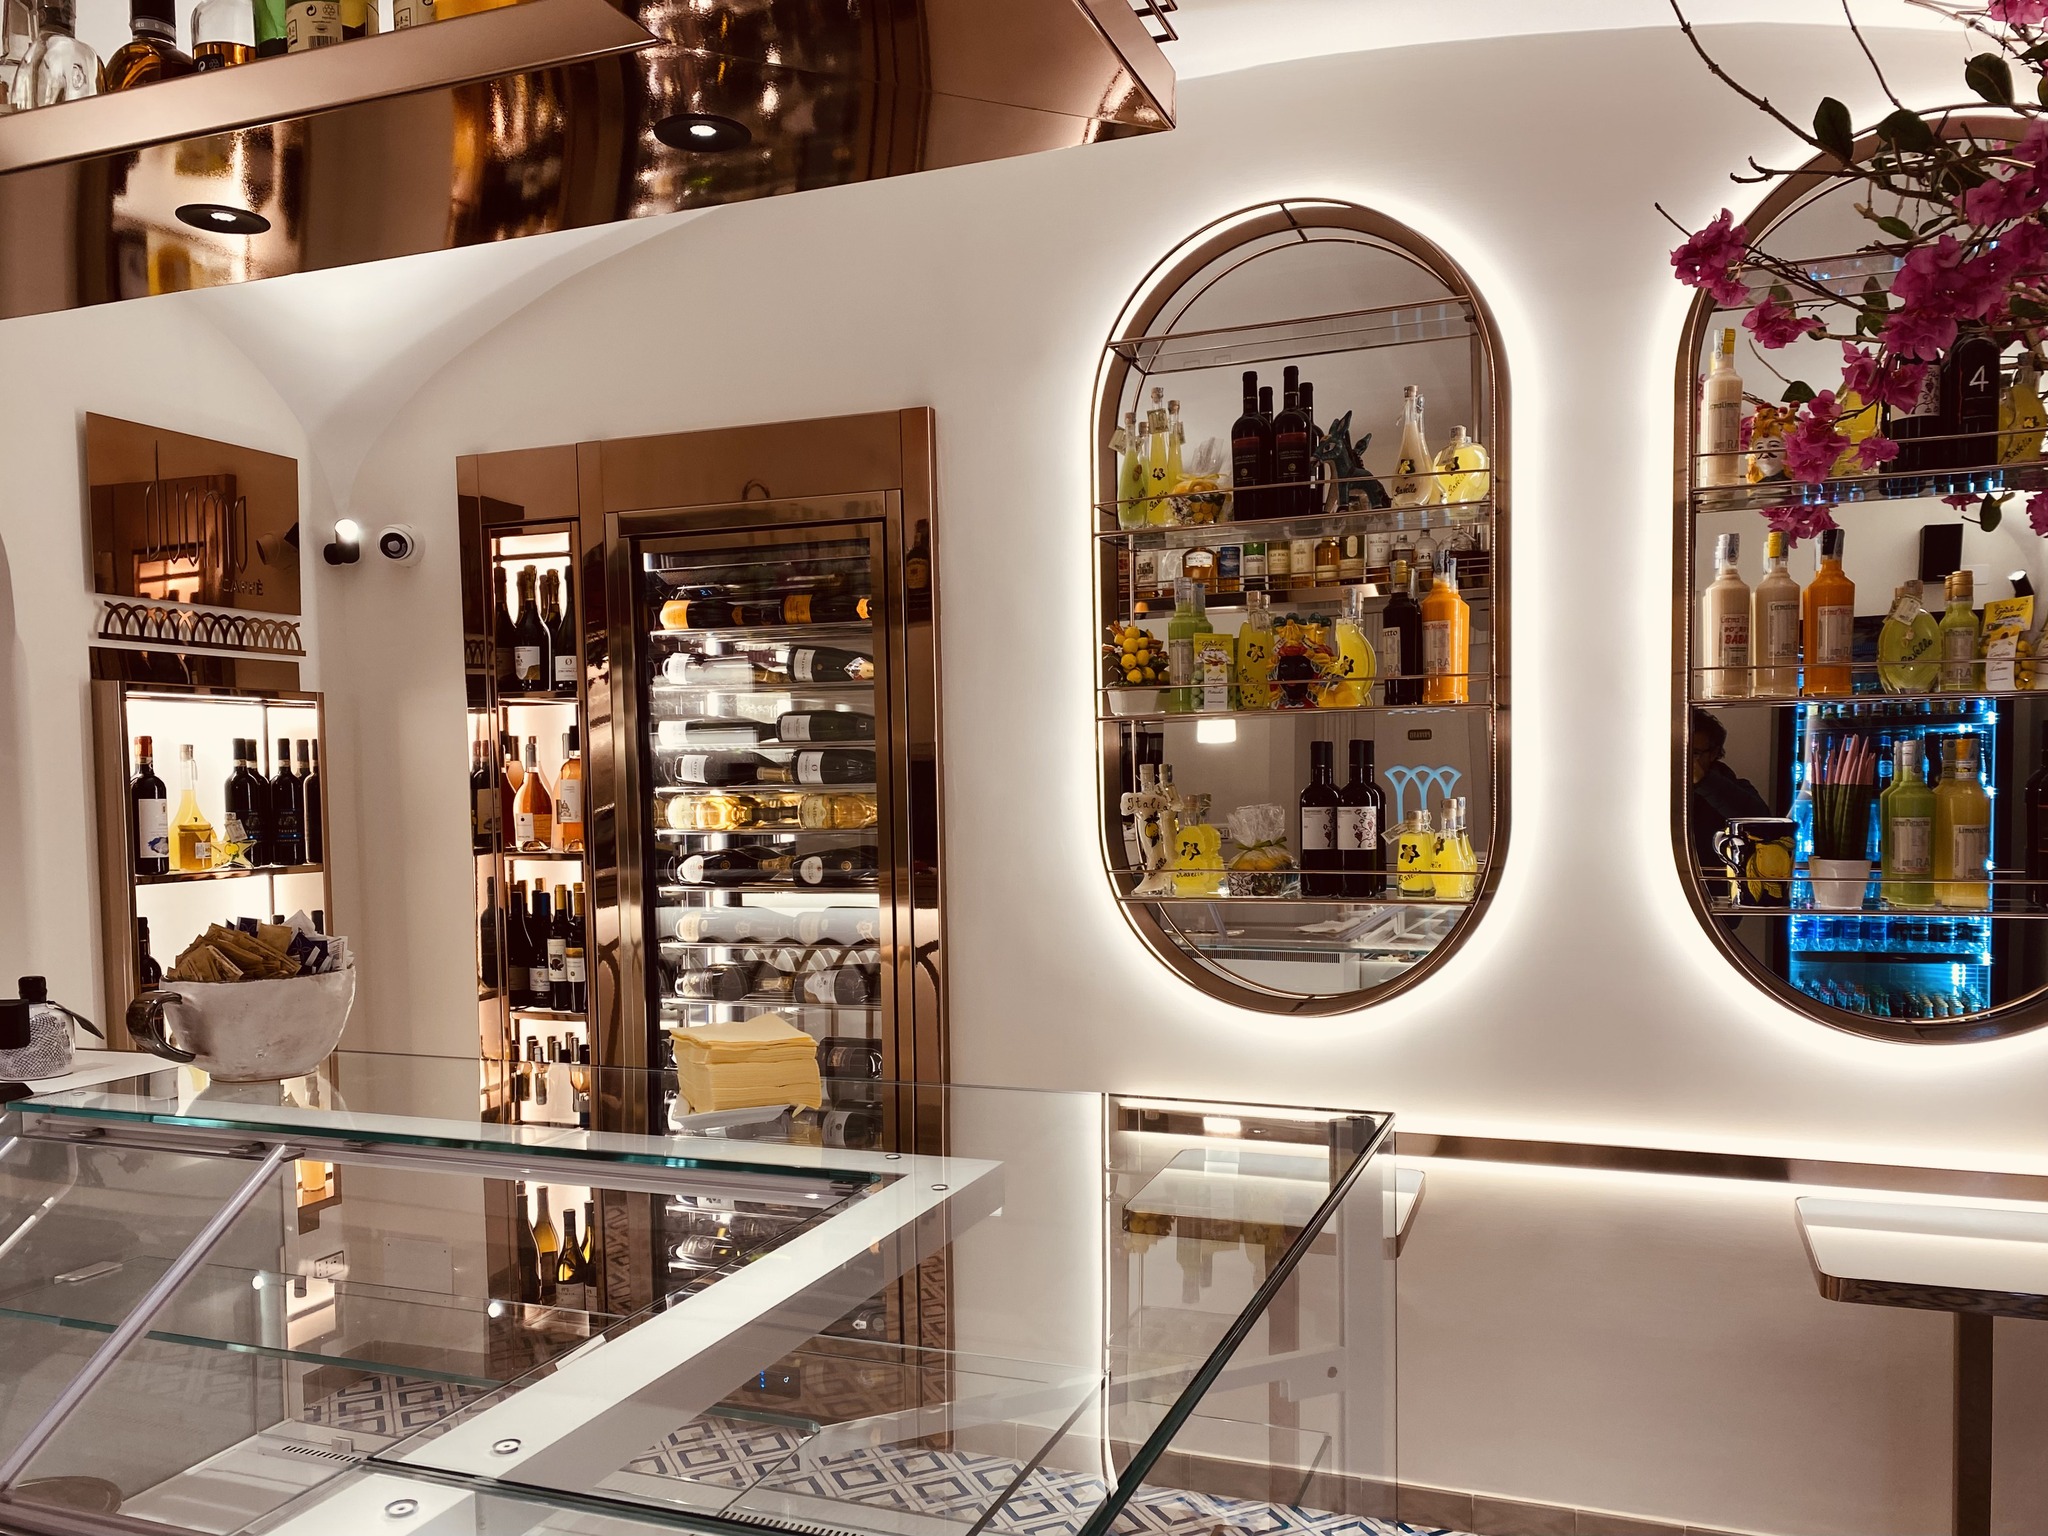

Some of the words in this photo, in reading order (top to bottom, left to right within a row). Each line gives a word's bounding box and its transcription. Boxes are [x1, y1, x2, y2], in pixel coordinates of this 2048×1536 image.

[1969, 365, 1989, 392] 4
[222, 578, 264, 596] CAFFÈ
[1387, 664, 1401, 672] RA
[1127, 796, 1171, 811] Italia
[1915, 858, 1931, 867] RA
